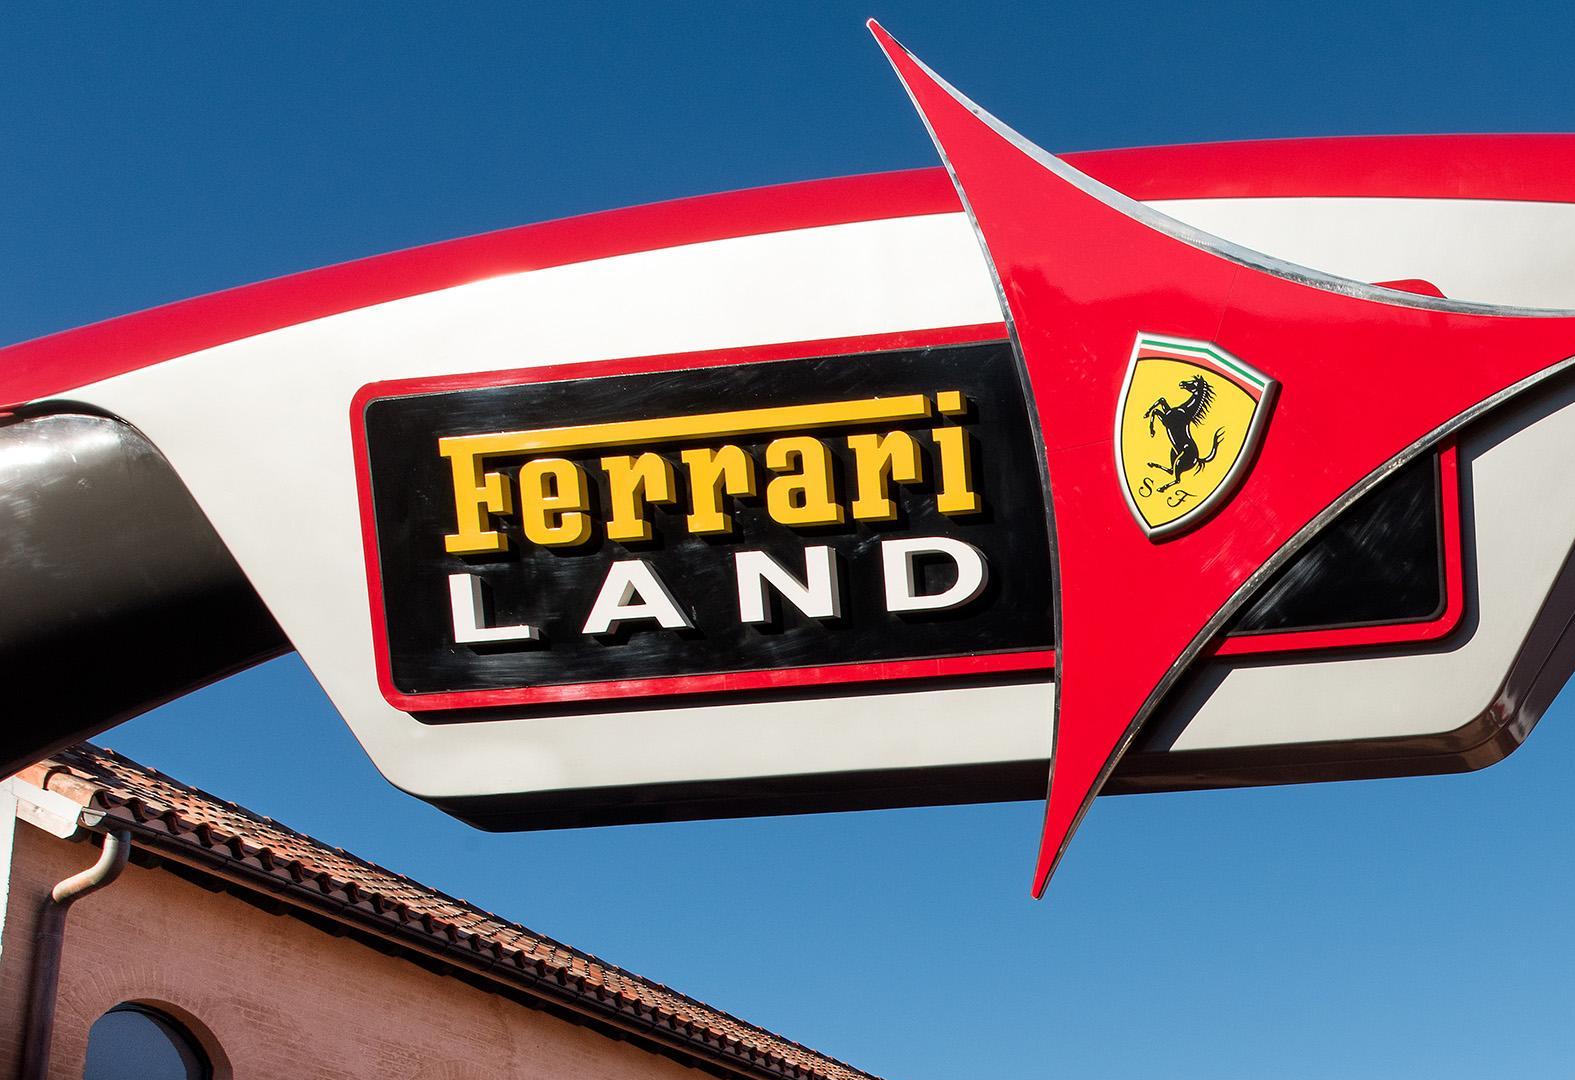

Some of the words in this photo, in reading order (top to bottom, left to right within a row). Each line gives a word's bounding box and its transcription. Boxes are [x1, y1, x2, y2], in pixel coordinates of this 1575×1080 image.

[438, 390, 979, 554] Ferrari
[1138, 477, 1154, 498] S
[1166, 489, 1199, 508] F
[448, 536, 989, 645] LAND
